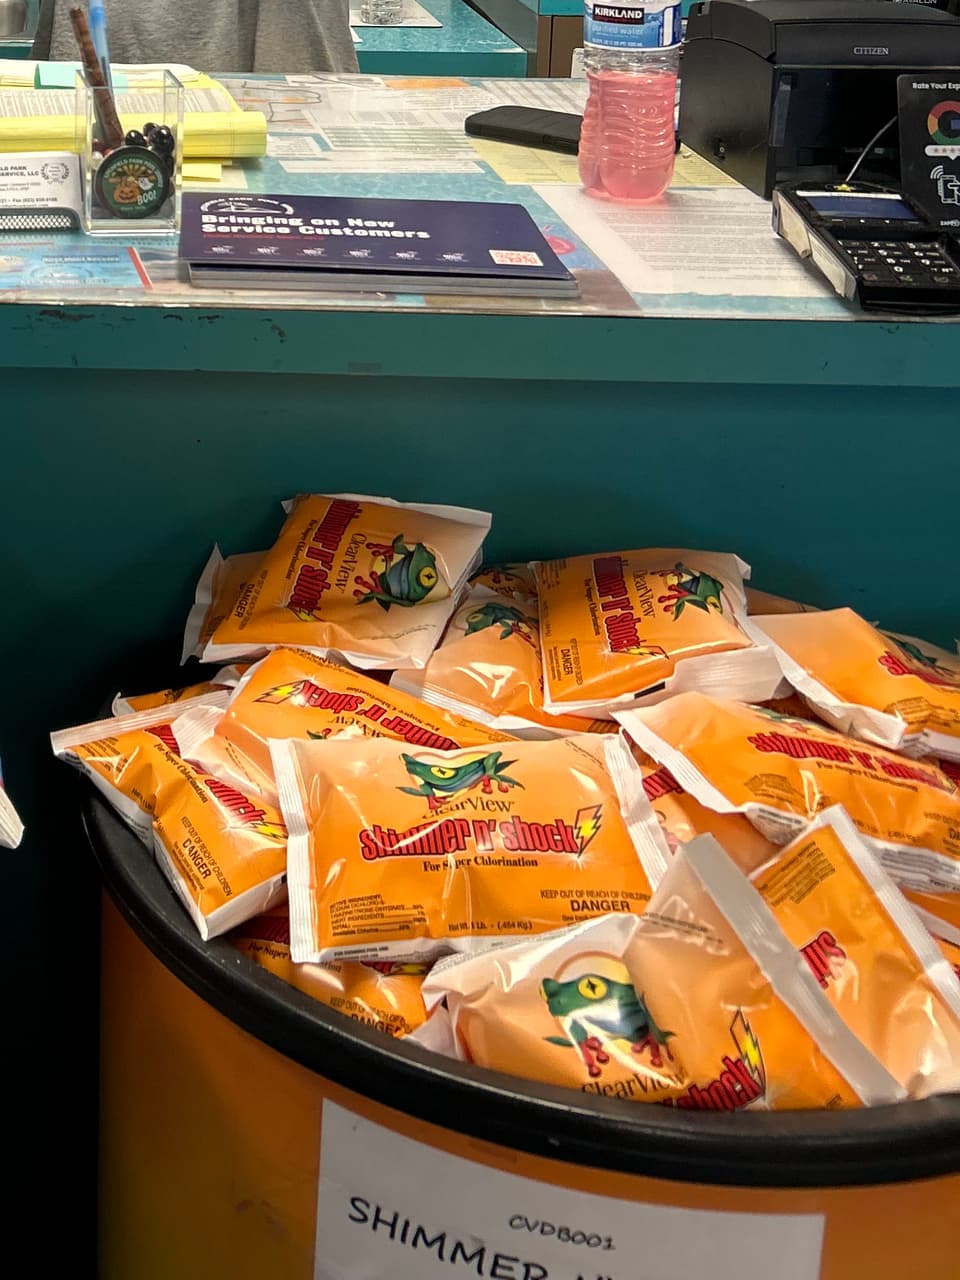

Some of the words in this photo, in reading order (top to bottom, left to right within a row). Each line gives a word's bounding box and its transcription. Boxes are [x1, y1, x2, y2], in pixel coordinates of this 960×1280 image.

[595, 7, 642, 19] KIRKLAND
[854, 46, 889, 55] CITIZEN
[931, 82, 946, 90] Your
[138, 191, 157, 205] BOO!
[201, 214, 303, 227] Bringing
[311, 218, 339, 226] on
[201, 223, 290, 235] Service
[299, 225, 431, 239] Customers
[334, 533, 367, 594] ClearView
[359, 818, 472, 861] shimmer
[474, 818, 497, 851] n'
[500, 816, 581, 855] shock
[182, 837, 212, 879] DANGER
[423, 861, 441, 873] For
[474, 857, 539, 868] Chlorination
[575, 890, 585, 899] OF
[571, 899, 631, 913] DANGER
[508, 1214, 617, 1251] CVDB001
